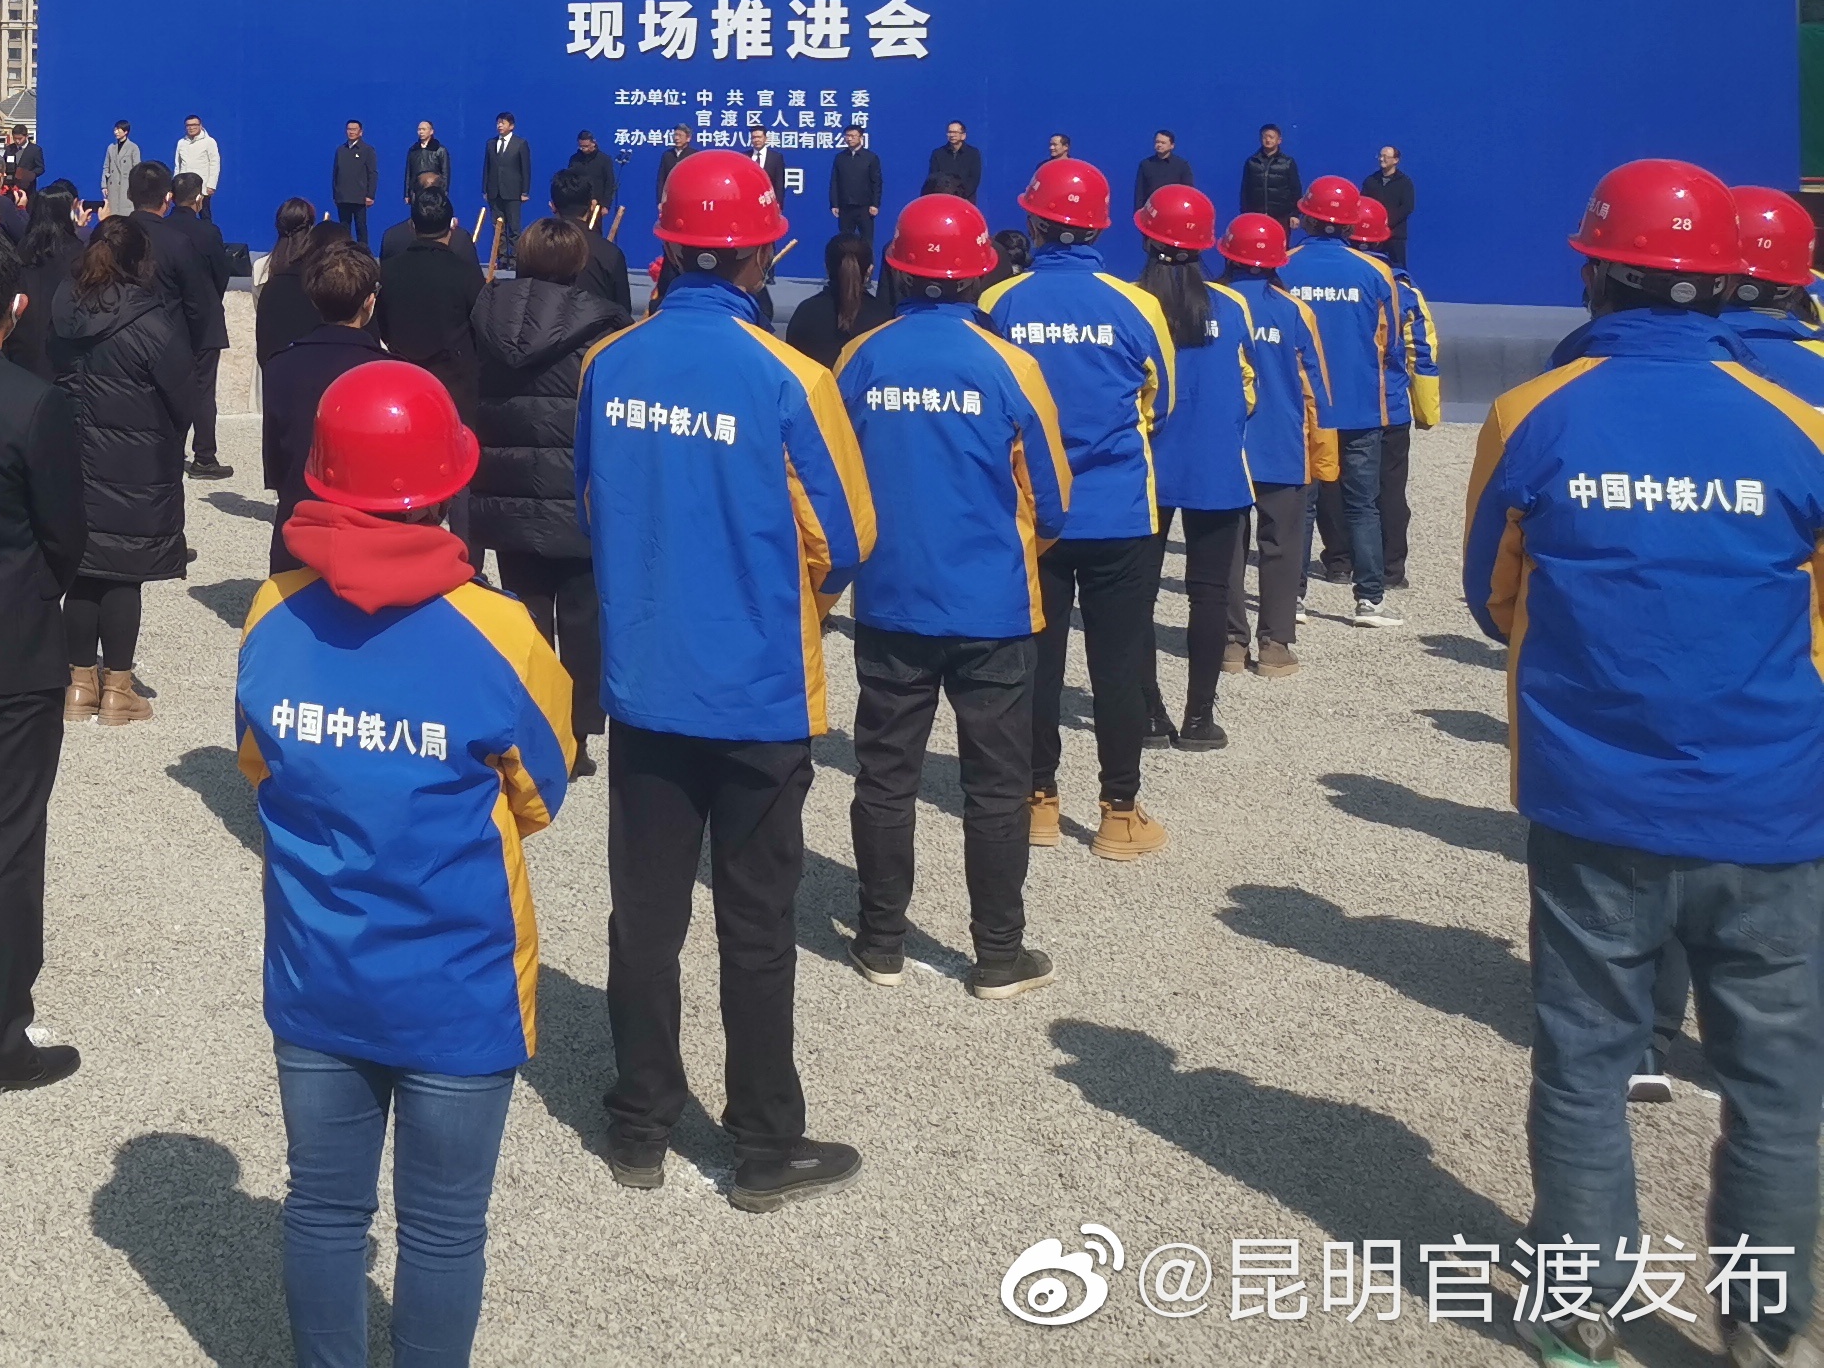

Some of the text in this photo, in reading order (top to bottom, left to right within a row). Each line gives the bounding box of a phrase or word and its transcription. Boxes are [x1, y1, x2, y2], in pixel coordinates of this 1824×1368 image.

[695, 109, 869, 129] 官渡区人民政府
[701, 200, 715, 211] 11
[1068, 194, 1080, 203] 08
[1671, 217, 1693, 231] 28
[927, 243, 941, 253] 24
[1757, 237, 1772, 249] 10
[1290, 286, 1359, 302] 中国中铁八局
[1011, 323, 1114, 346] 中国中铁八局
[866, 386, 981, 415] 中国中铁八局
[606, 397, 736, 445] 中国中铁八局
[1569, 472, 1765, 516] 中国中铁八局
[272, 699, 447, 761] 中国中铁八局
